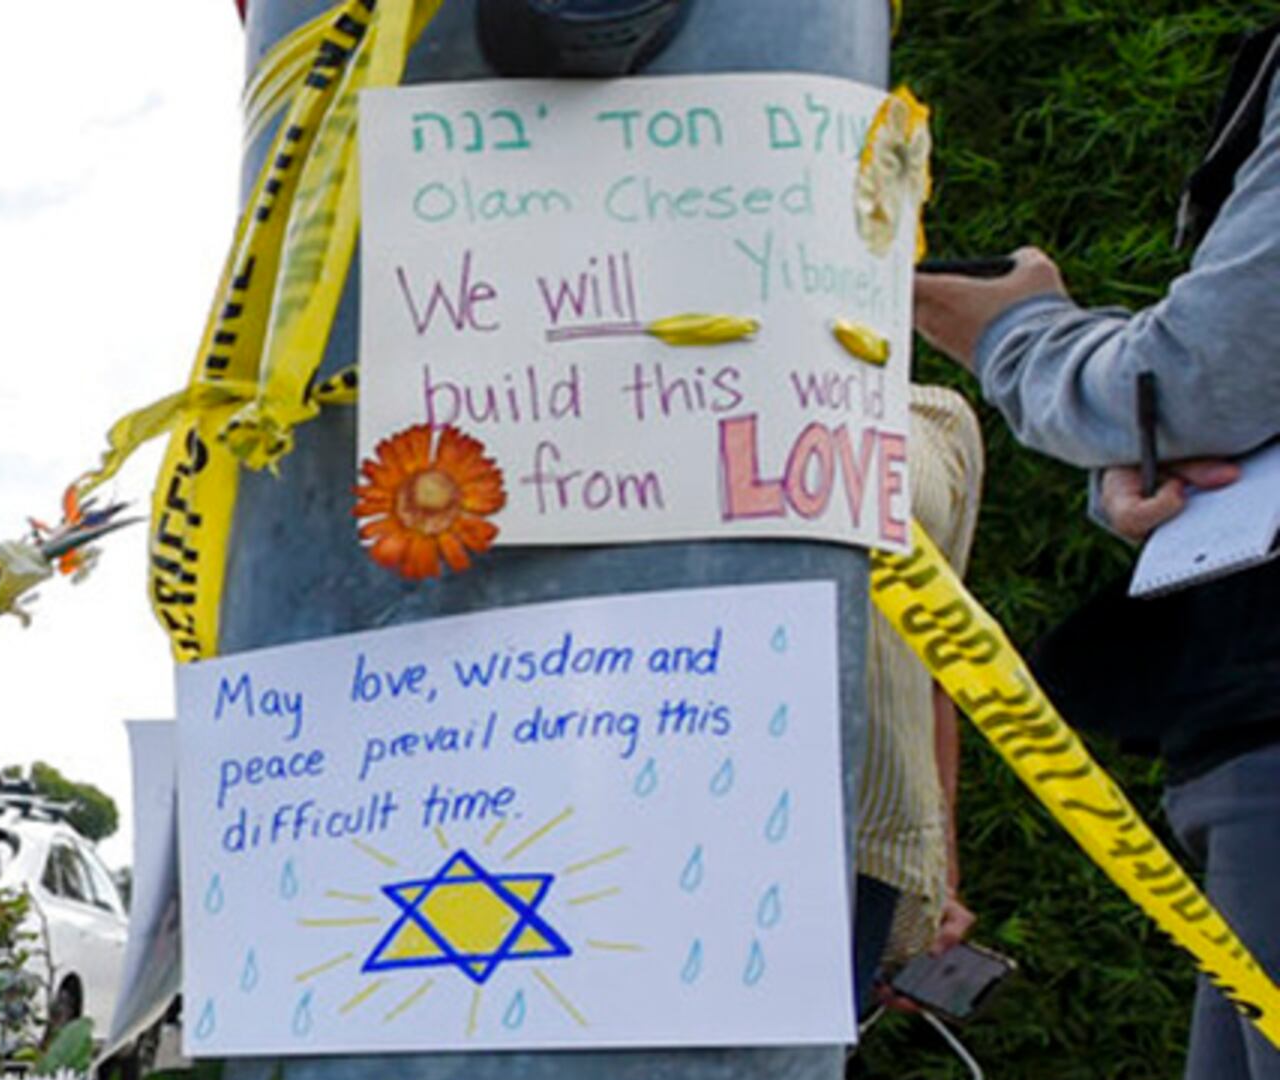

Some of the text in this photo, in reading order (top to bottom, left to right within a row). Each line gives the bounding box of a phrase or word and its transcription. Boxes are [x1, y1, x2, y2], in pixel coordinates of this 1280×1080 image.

[412, 101, 549, 152] יבנה
[596, 107, 724, 149] חסד
[412, 168, 814, 223] Olam Chesed
[395, 249, 642, 336] We will
[422, 362, 581, 430] build
[620, 362, 744, 422] this
[789, 366, 886, 420] world
[518, 412, 907, 545] from LOVE
[214, 625, 723, 742] May love, wisdom and
[216, 697, 733, 811] peace prevail during this
[221, 782, 524, 853] difficult time.
